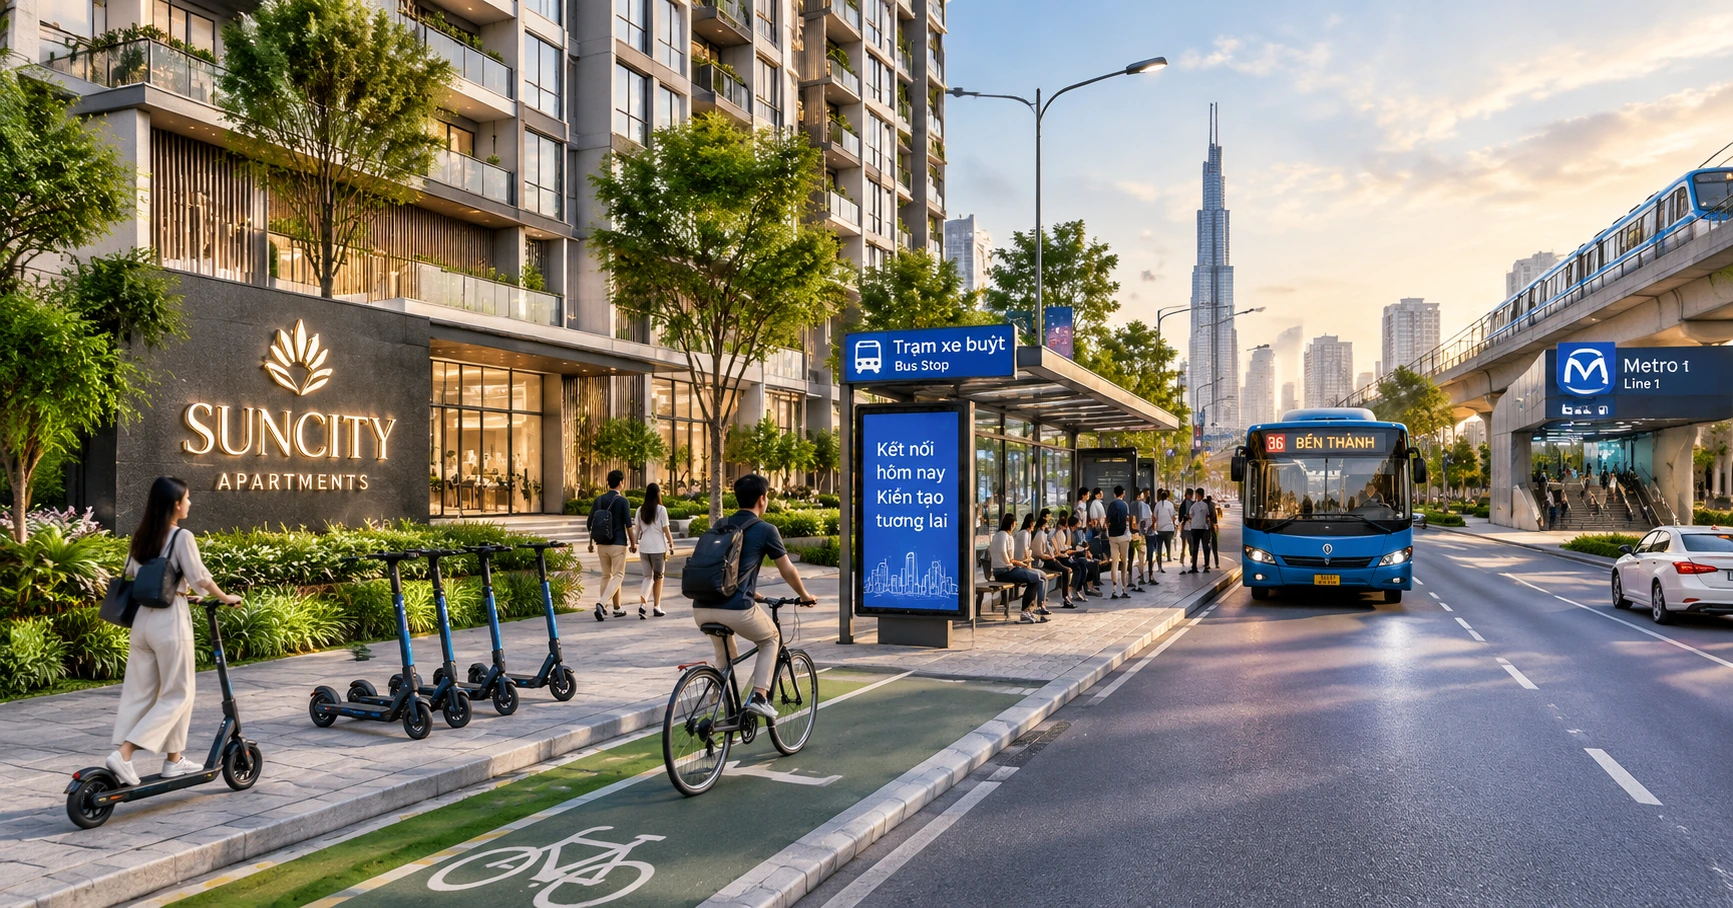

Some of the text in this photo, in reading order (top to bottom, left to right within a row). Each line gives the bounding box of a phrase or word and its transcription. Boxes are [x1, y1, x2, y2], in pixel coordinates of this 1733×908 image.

[893, 339, 937, 357] Trạm
[941, 340, 962, 353] xe
[895, 359, 950, 373] Bus Stop
[1624, 357, 1679, 374] Metro
[1624, 377, 1661, 389] Line 1
[182, 401, 397, 460] SUNCITY
[1268, 436, 1284, 450] 36
[217, 472, 370, 491] APARTMENTS
[916, 467, 946, 484] nay
[916, 489, 944, 509] tạo
[929, 512, 948, 528] lai
